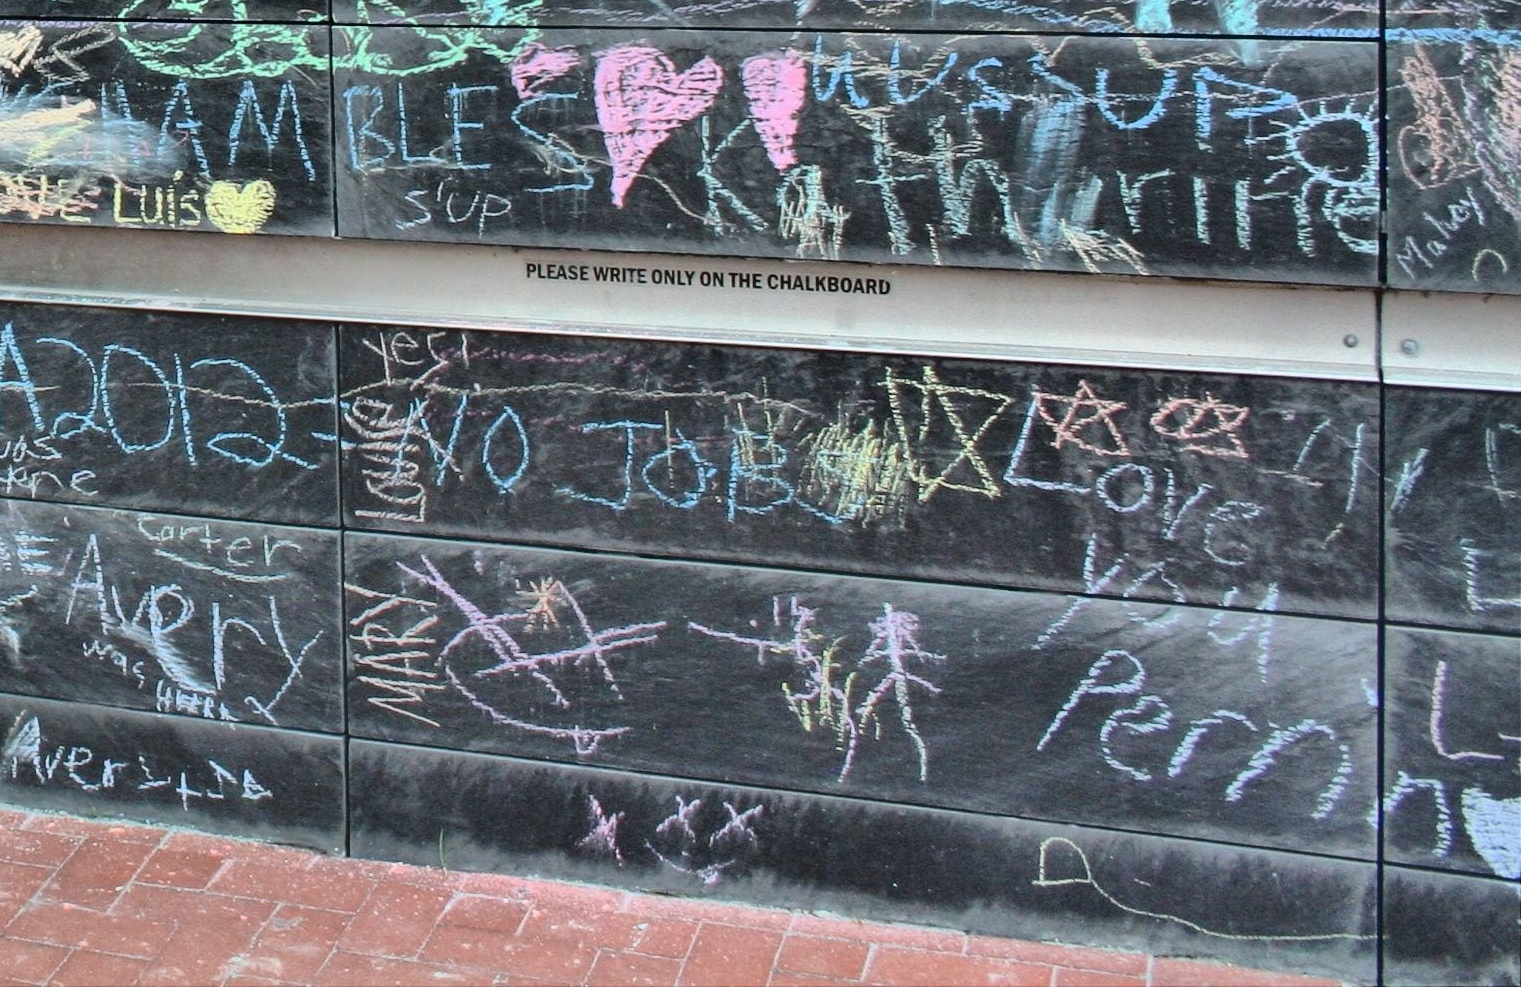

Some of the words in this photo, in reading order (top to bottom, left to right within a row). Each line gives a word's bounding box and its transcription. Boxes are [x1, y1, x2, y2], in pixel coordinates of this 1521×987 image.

[112, 169, 203, 230] Luis
[526, 262, 590, 282] PLEASE
[592, 266, 648, 284] WRITE
[651, 268, 696, 287] ONLY
[699, 270, 725, 288] ON
[728, 272, 764, 289] THE
[766, 274, 892, 296] CHALKBOARD
